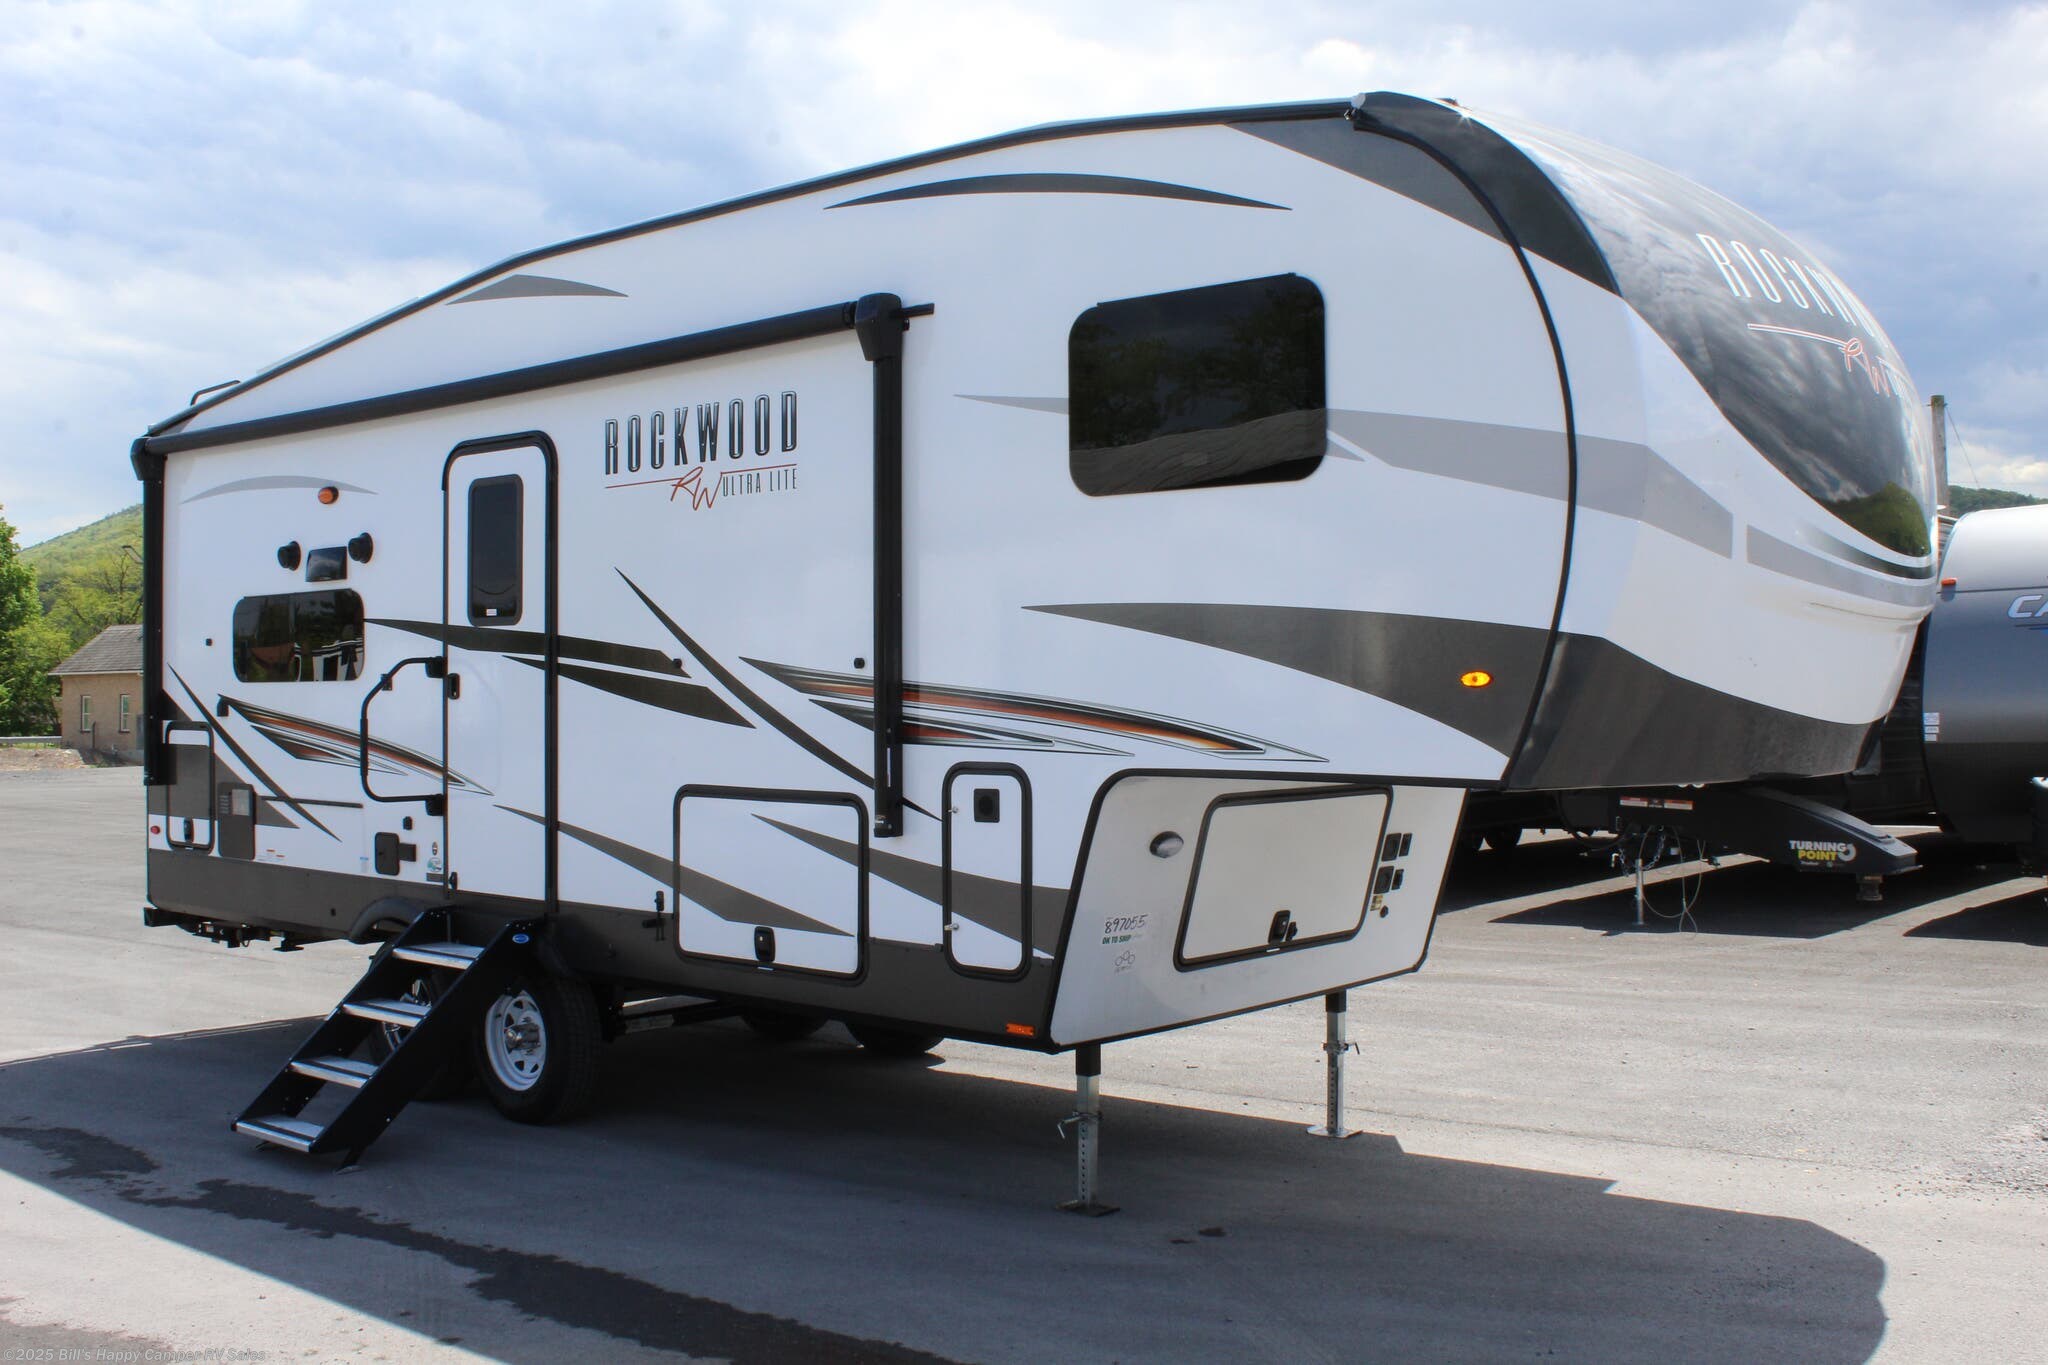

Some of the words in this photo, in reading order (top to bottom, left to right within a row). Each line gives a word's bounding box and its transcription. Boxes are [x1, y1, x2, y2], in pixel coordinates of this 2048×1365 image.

[1696, 233, 1889, 348] ROCKW
[605, 390, 797, 475] ROCKWOOD
[722, 472, 761, 497] ULTRA
[769, 468, 798, 491] LITE
[1789, 840, 1847, 852] TURNING
[1797, 850, 1837, 860] POINT
[1104, 914, 1148, 935] 897055
